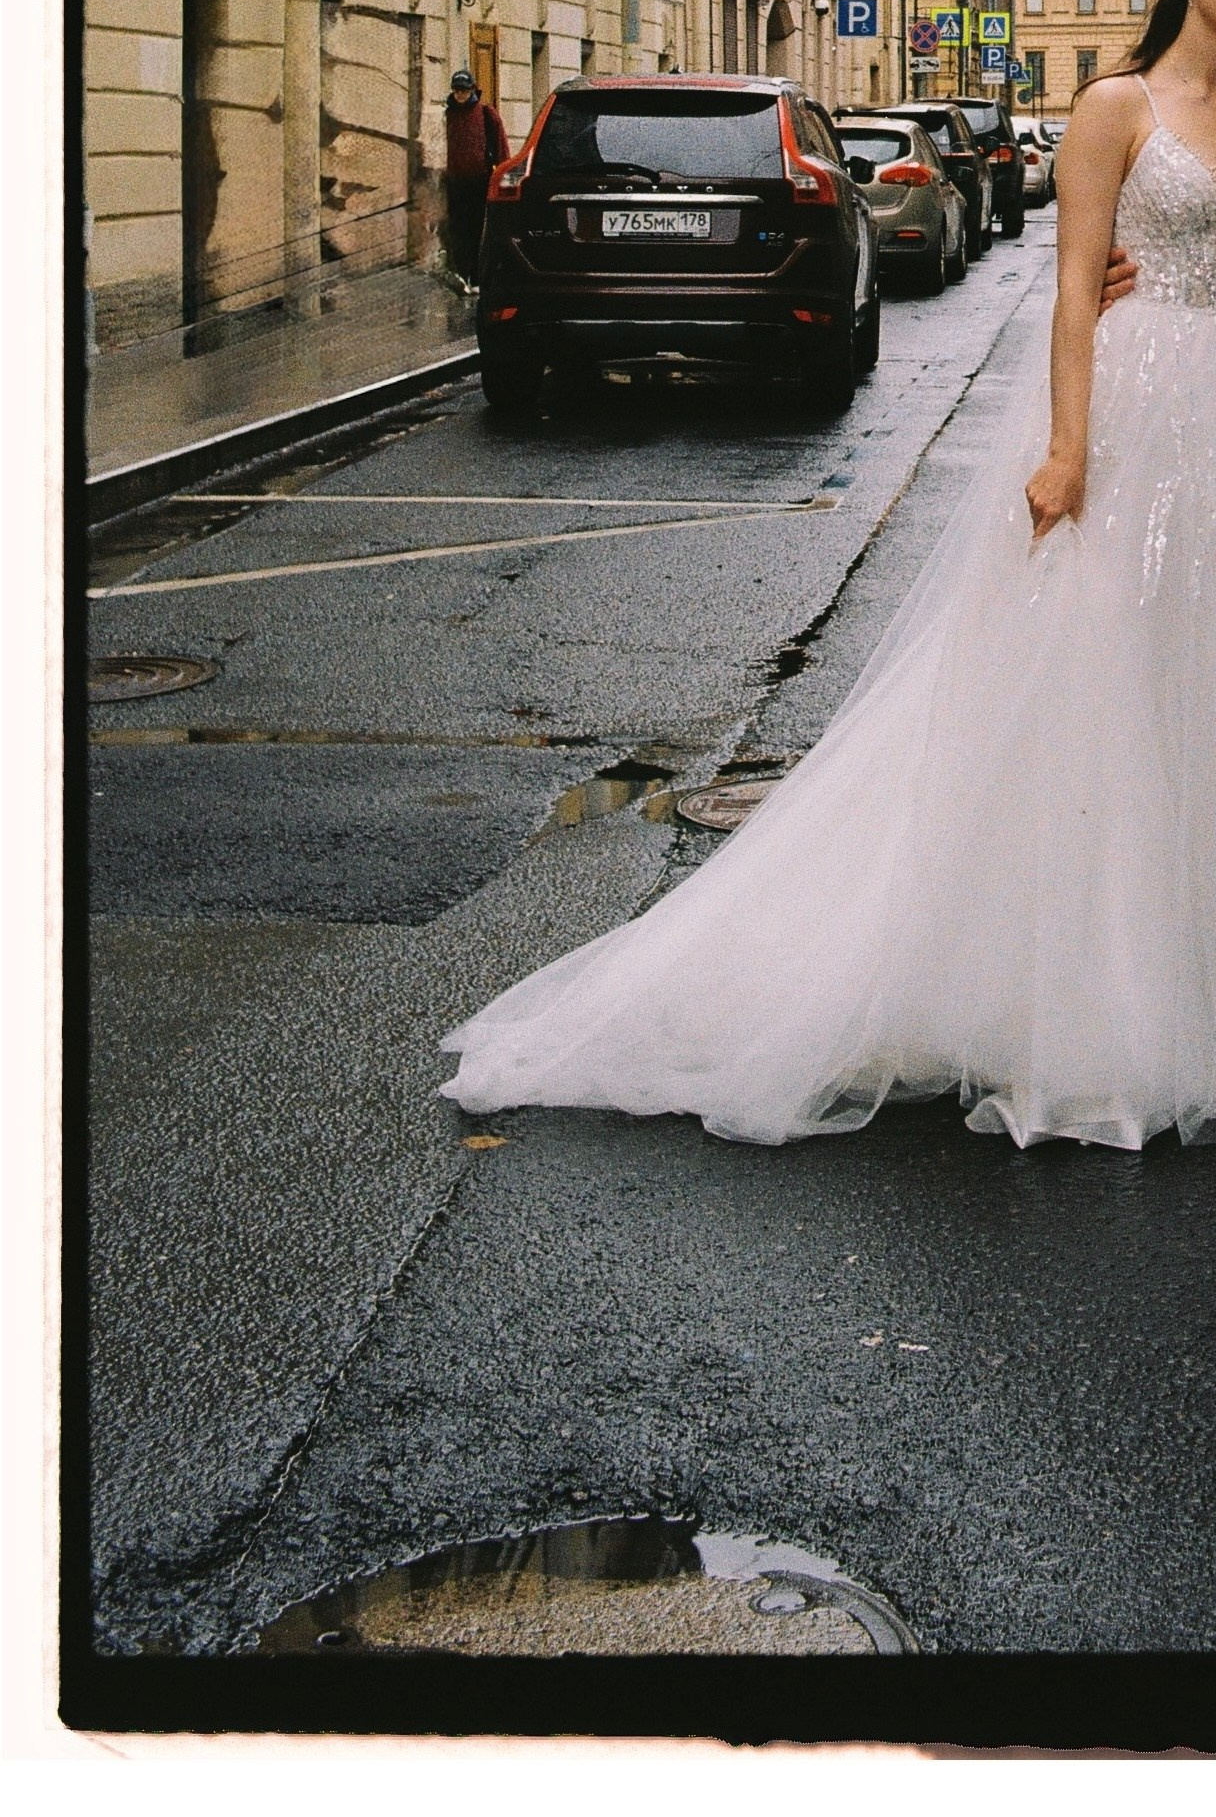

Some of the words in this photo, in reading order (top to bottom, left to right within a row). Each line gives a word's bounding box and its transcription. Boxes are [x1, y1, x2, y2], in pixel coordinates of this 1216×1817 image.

[848, 1, 871, 33] P
[987, 48, 1001, 67] P
[1009, 63, 1020, 78] P
[680, 213, 706, 227] 178
